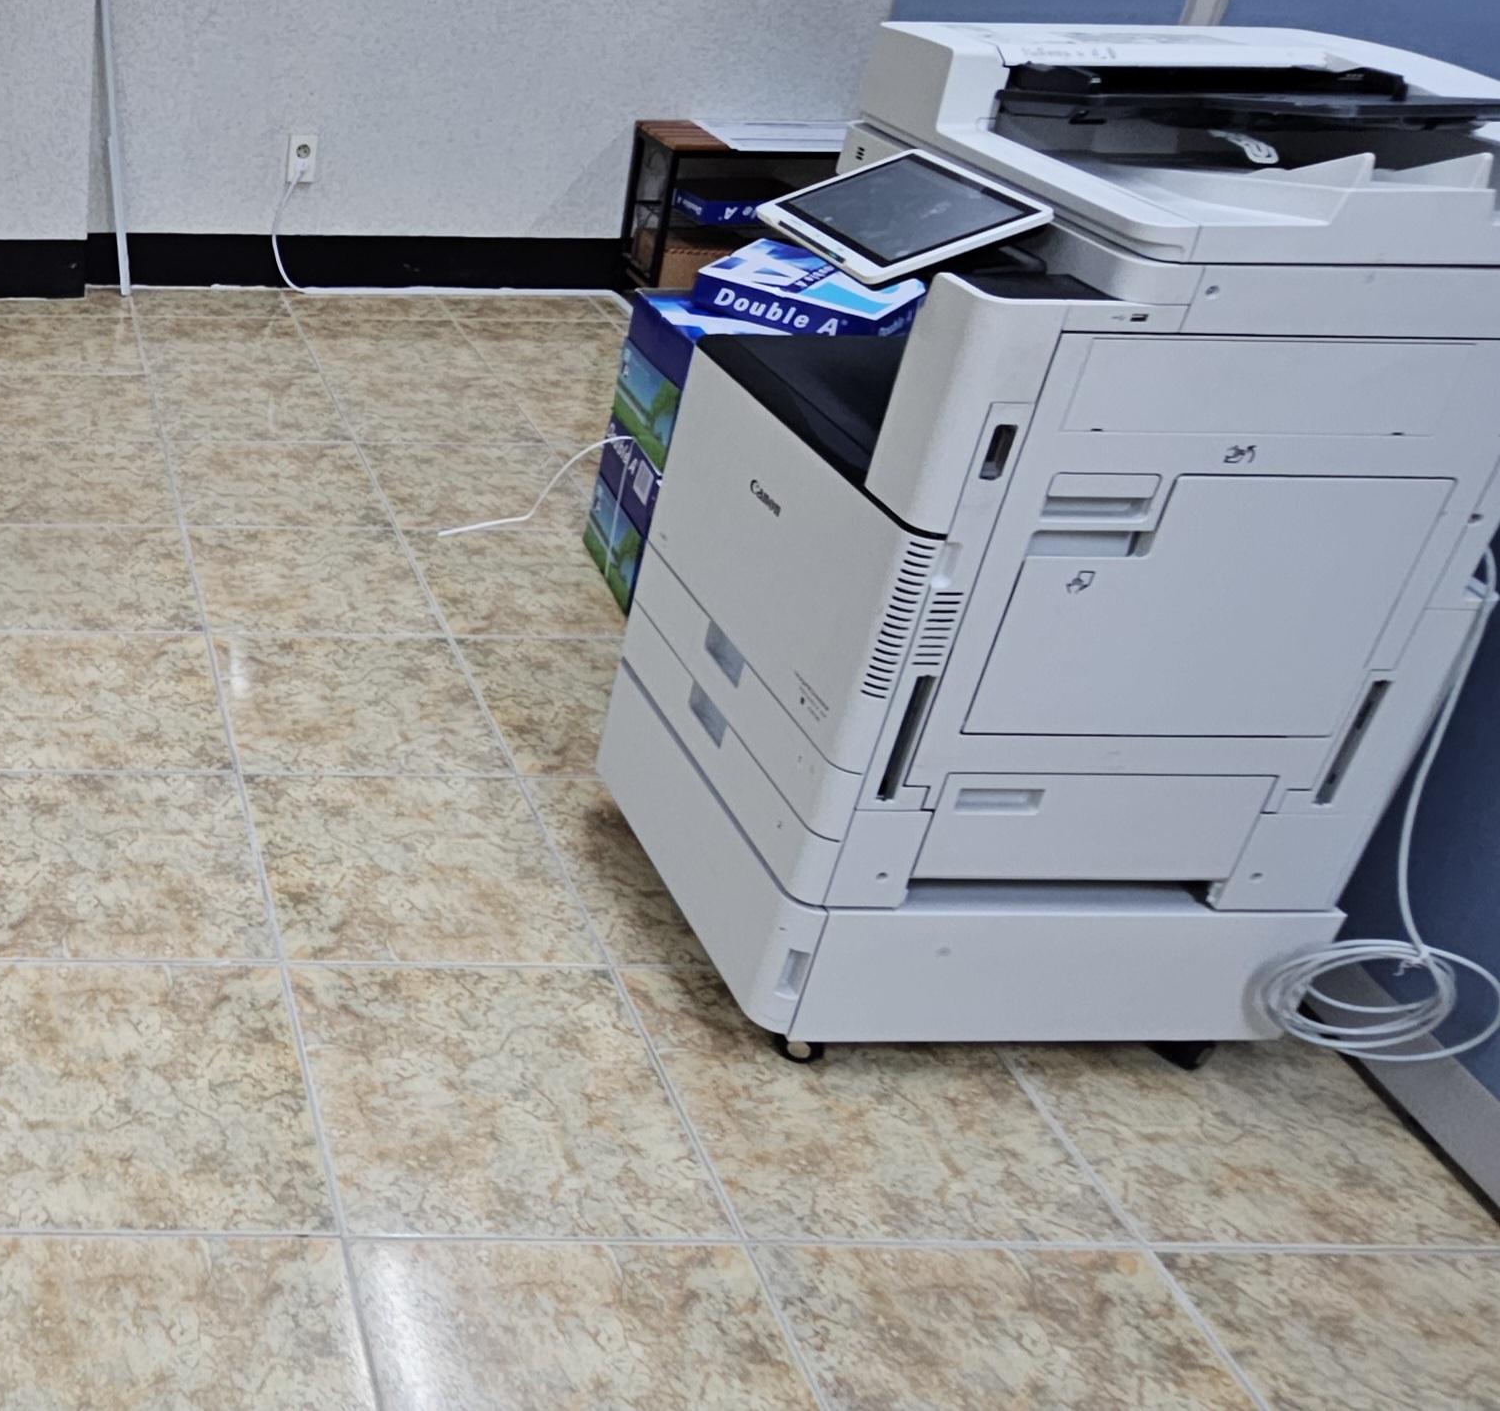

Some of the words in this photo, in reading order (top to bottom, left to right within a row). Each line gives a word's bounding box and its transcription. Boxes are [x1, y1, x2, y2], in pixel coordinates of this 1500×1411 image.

[713, 287, 810, 329] Double
[817, 317, 840, 336] A
[750, 479, 781, 517] Canon
